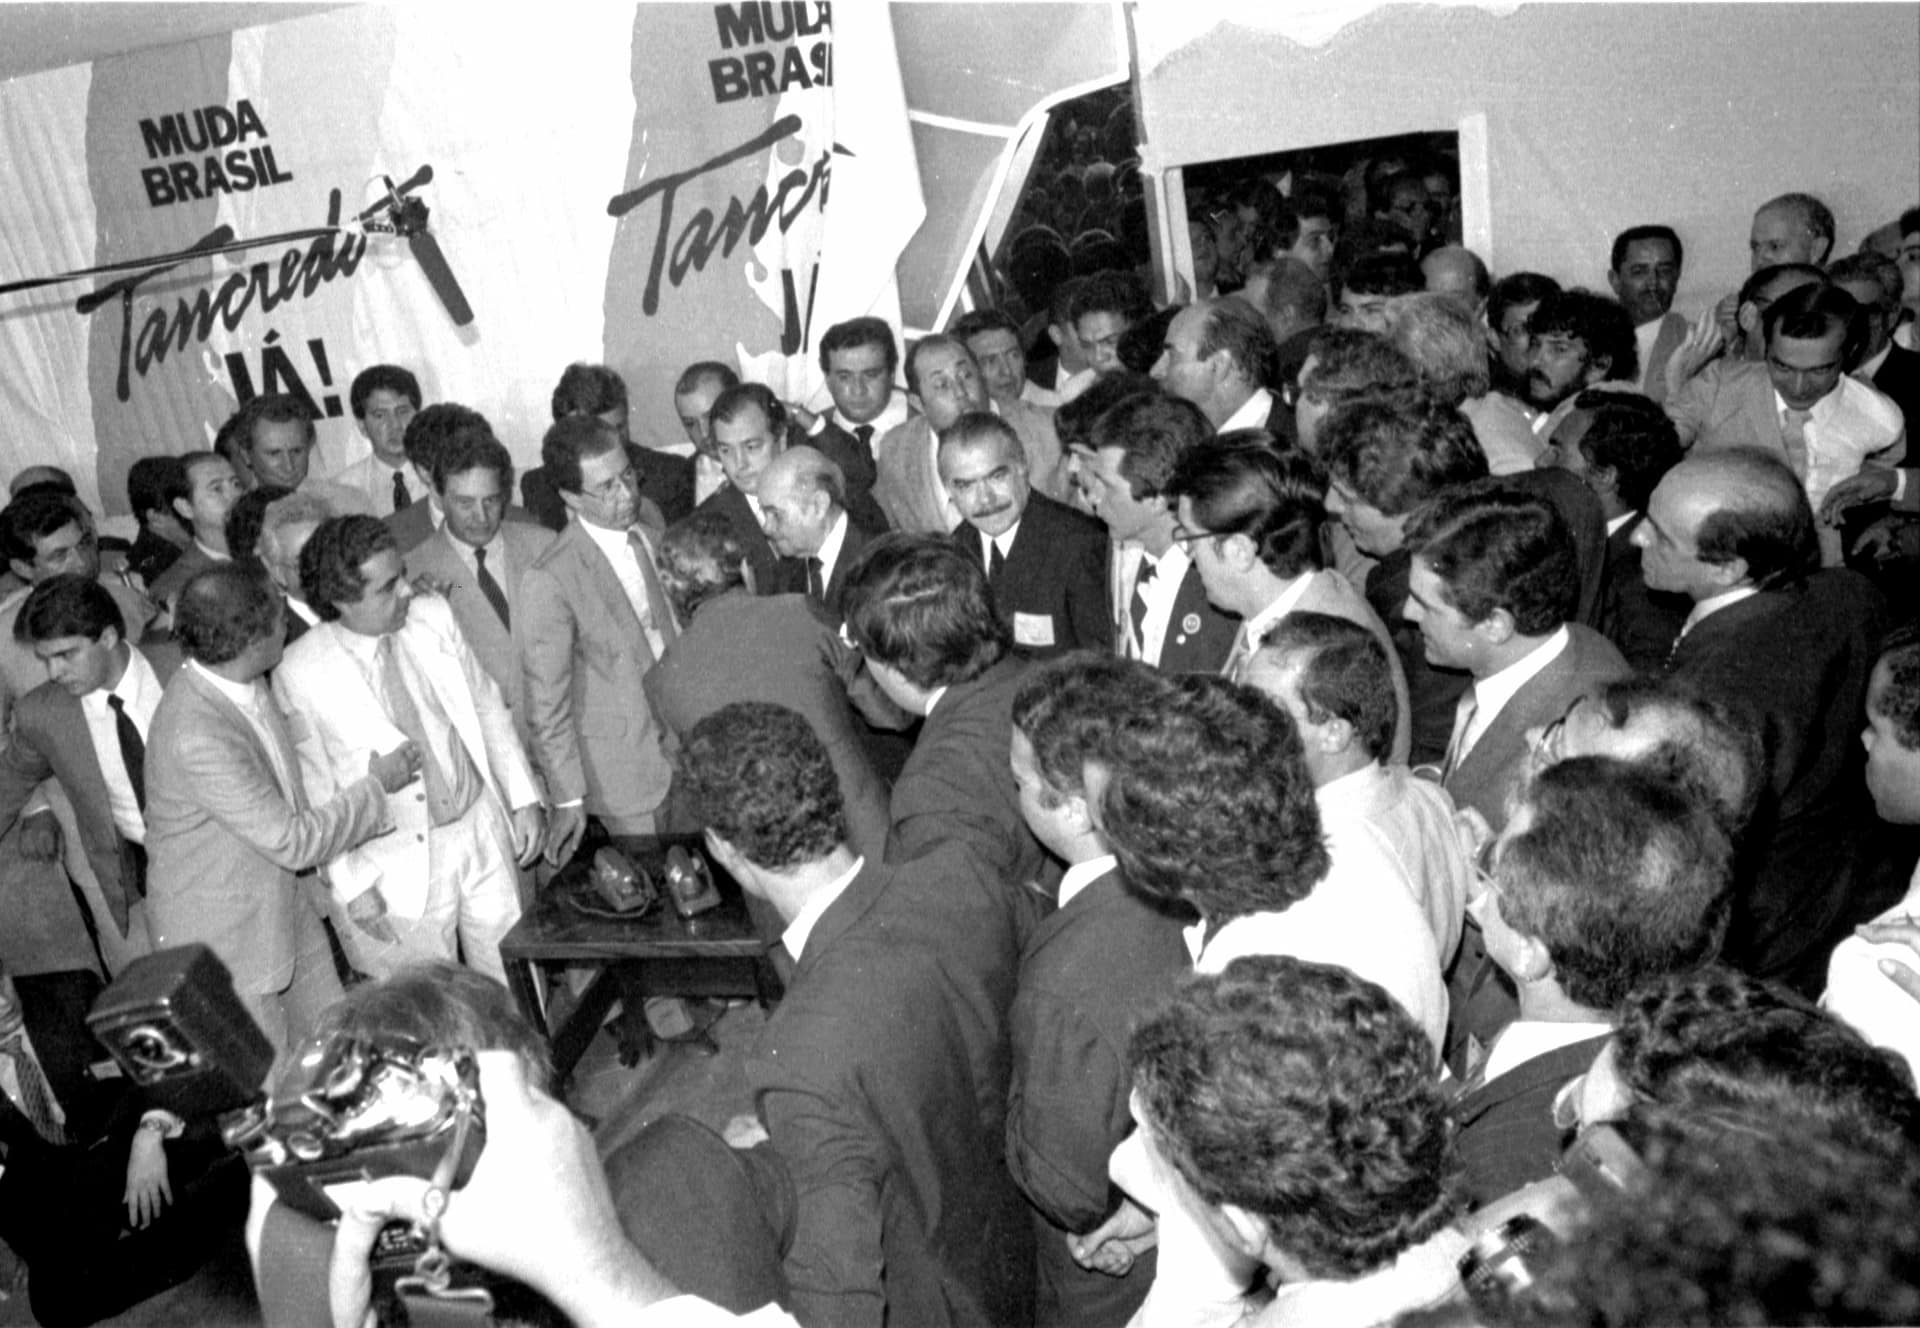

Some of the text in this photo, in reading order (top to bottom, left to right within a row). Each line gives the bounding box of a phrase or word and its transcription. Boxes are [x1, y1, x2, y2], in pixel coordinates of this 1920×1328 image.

[708, 41, 833, 104] BRASI
[138, 98, 268, 159] MUDA
[141, 144, 294, 208] BRASIL
[76, 164, 434, 402] Tancredo
